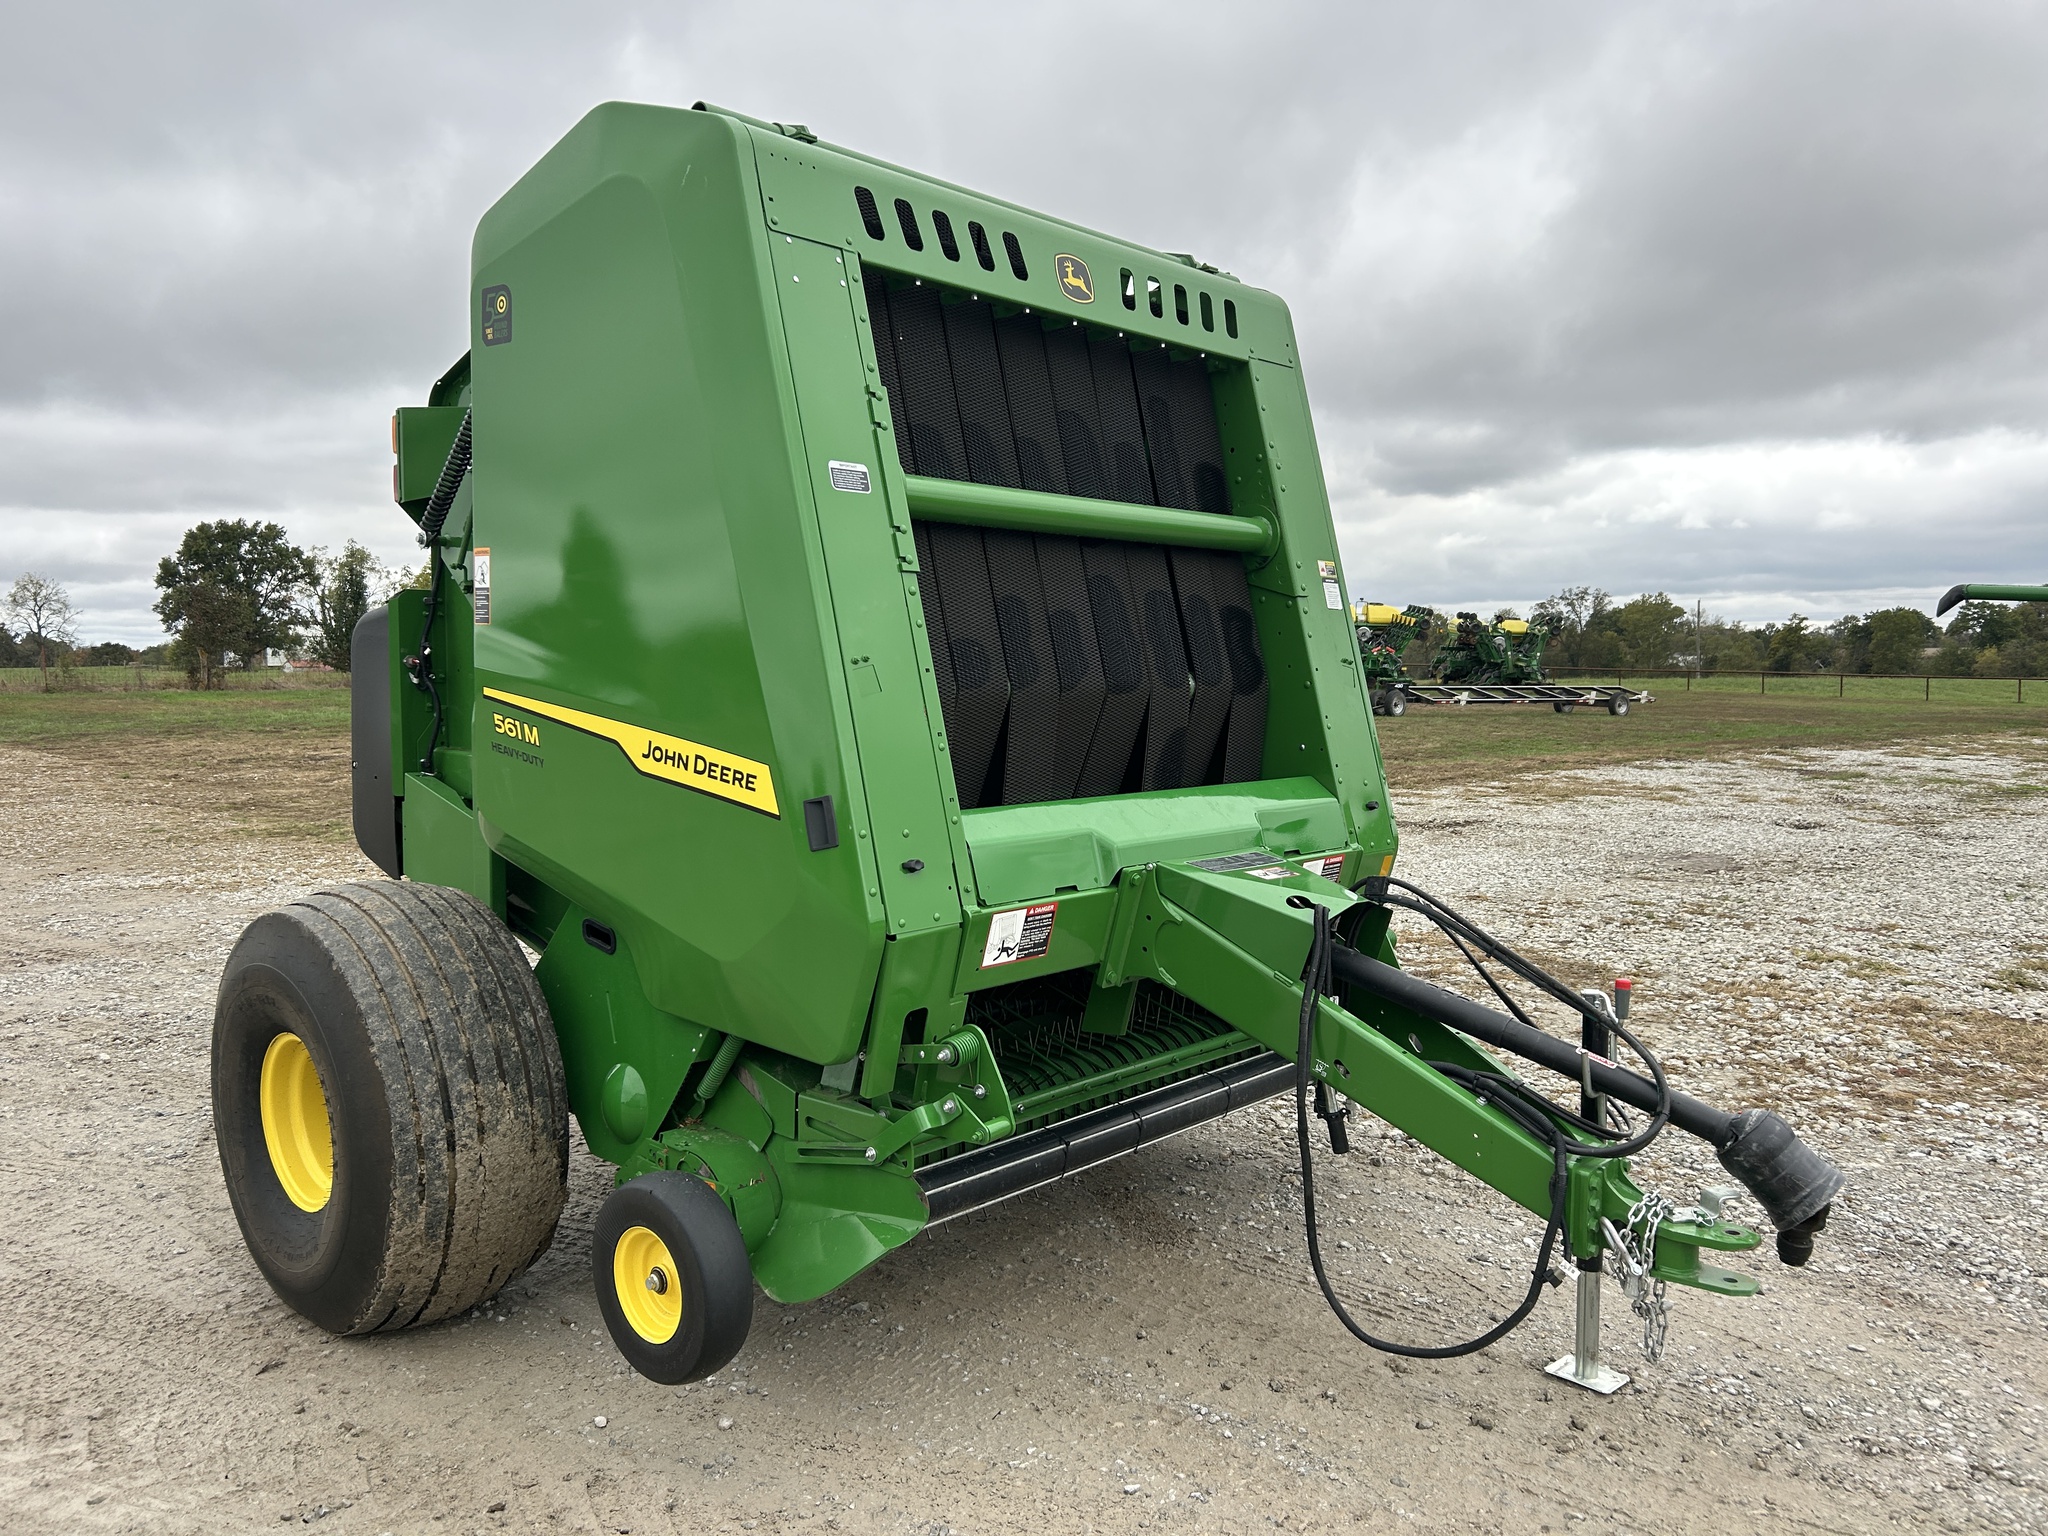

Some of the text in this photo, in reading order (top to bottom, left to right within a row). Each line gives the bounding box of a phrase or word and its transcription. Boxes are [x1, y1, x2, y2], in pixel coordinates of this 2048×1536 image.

[492, 712, 540, 747] 561M
[491, 741, 544, 768] HEAVY-DUTY
[642, 740, 757, 792] JOHN DEERE
[1034, 905, 1054, 913] DANGER
